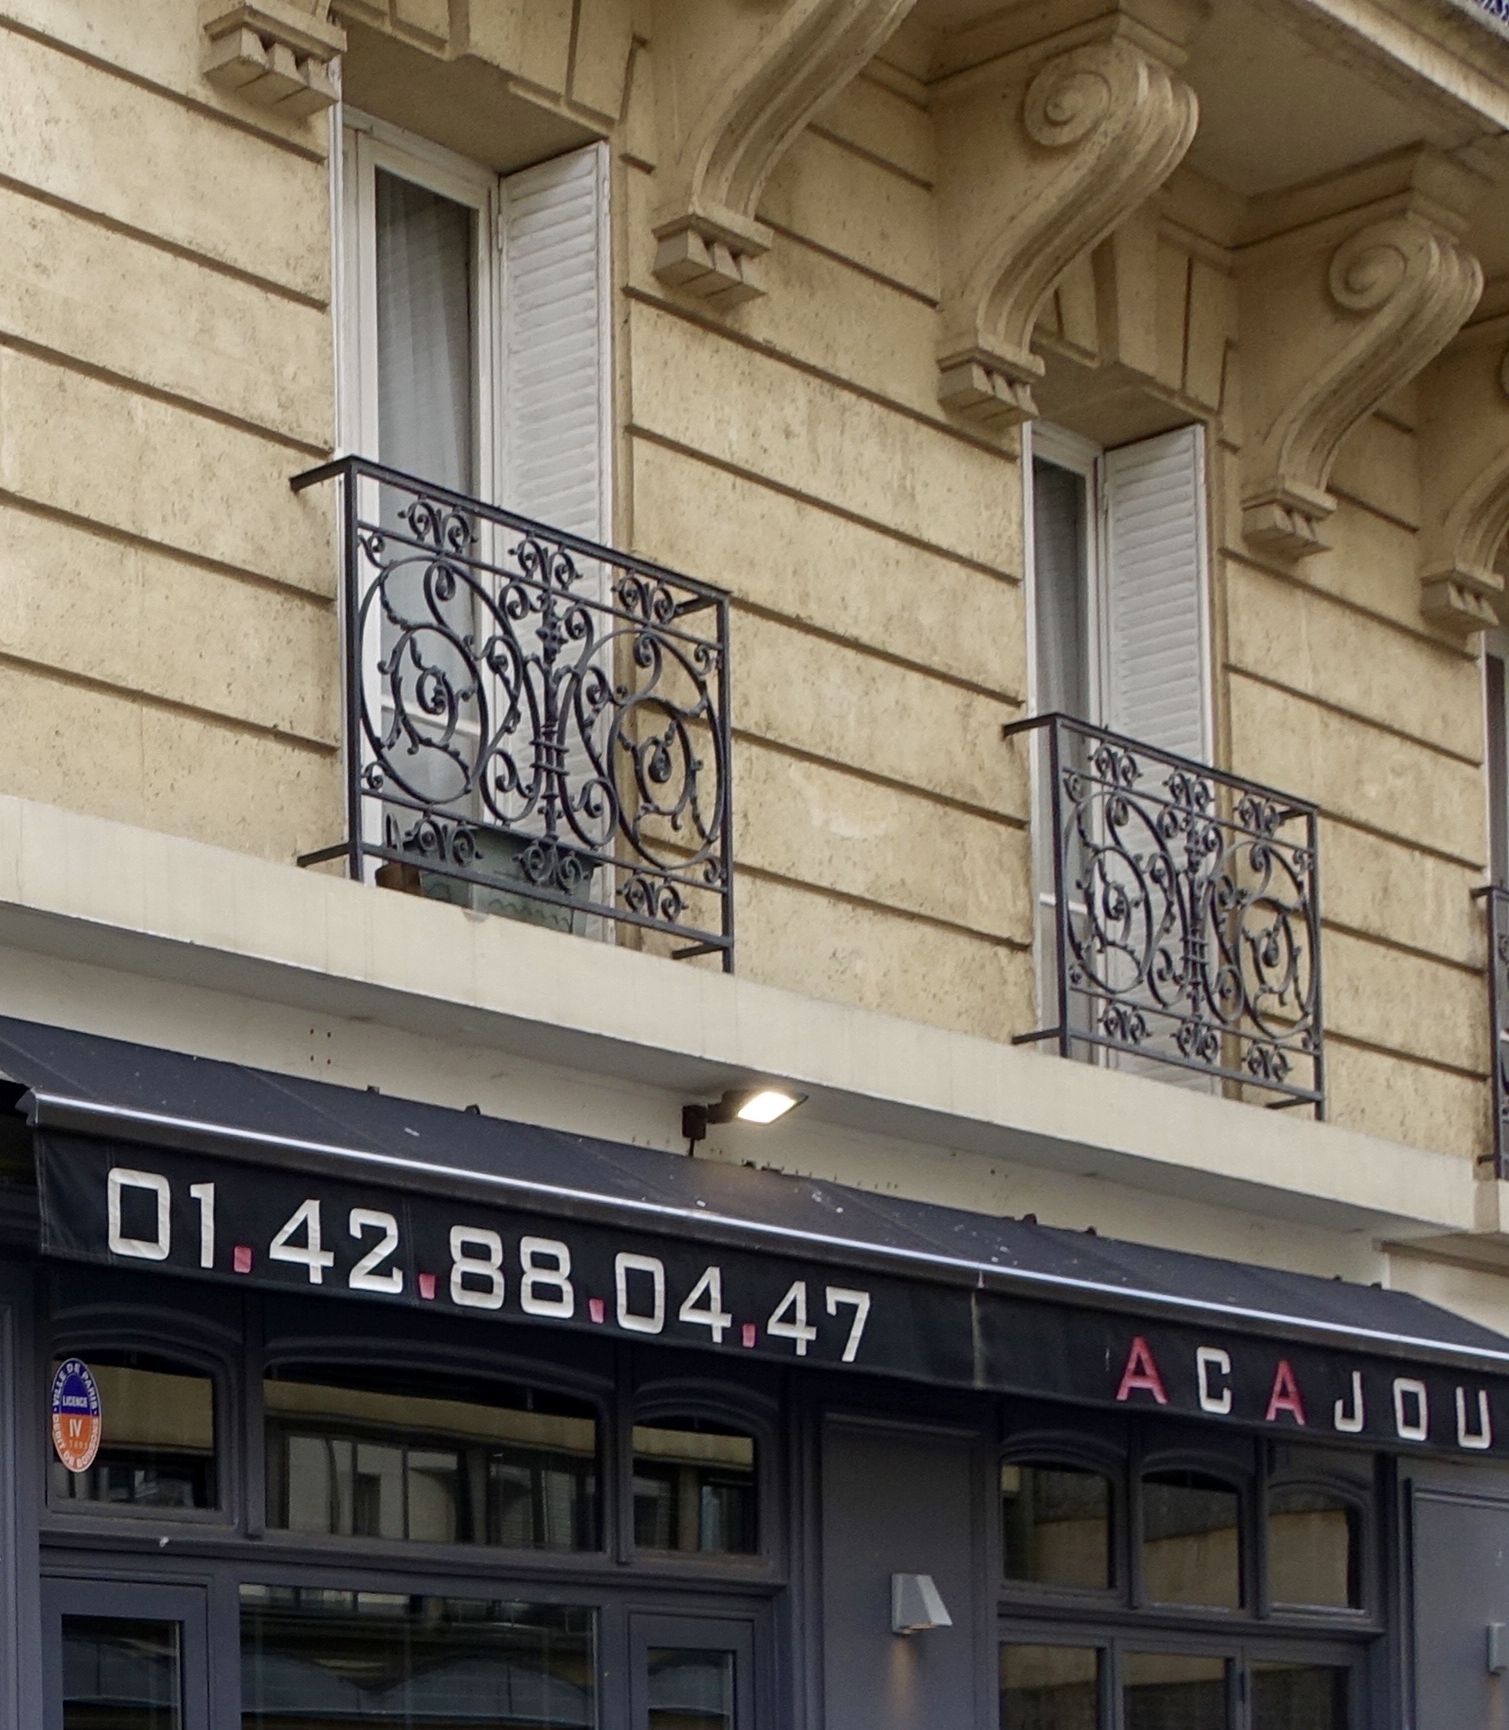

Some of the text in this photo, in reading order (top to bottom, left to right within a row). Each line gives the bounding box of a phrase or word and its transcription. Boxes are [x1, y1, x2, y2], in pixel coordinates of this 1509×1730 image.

[107, 1168, 872, 1363] 01.42.88.04.47
[52, 1362, 98, 1410] VILLE DE PARIS
[62, 1395, 88, 1408] LICENCE
[1116, 1336, 1491, 1449] ACAJOU
[69, 1418, 83, 1438] IV
